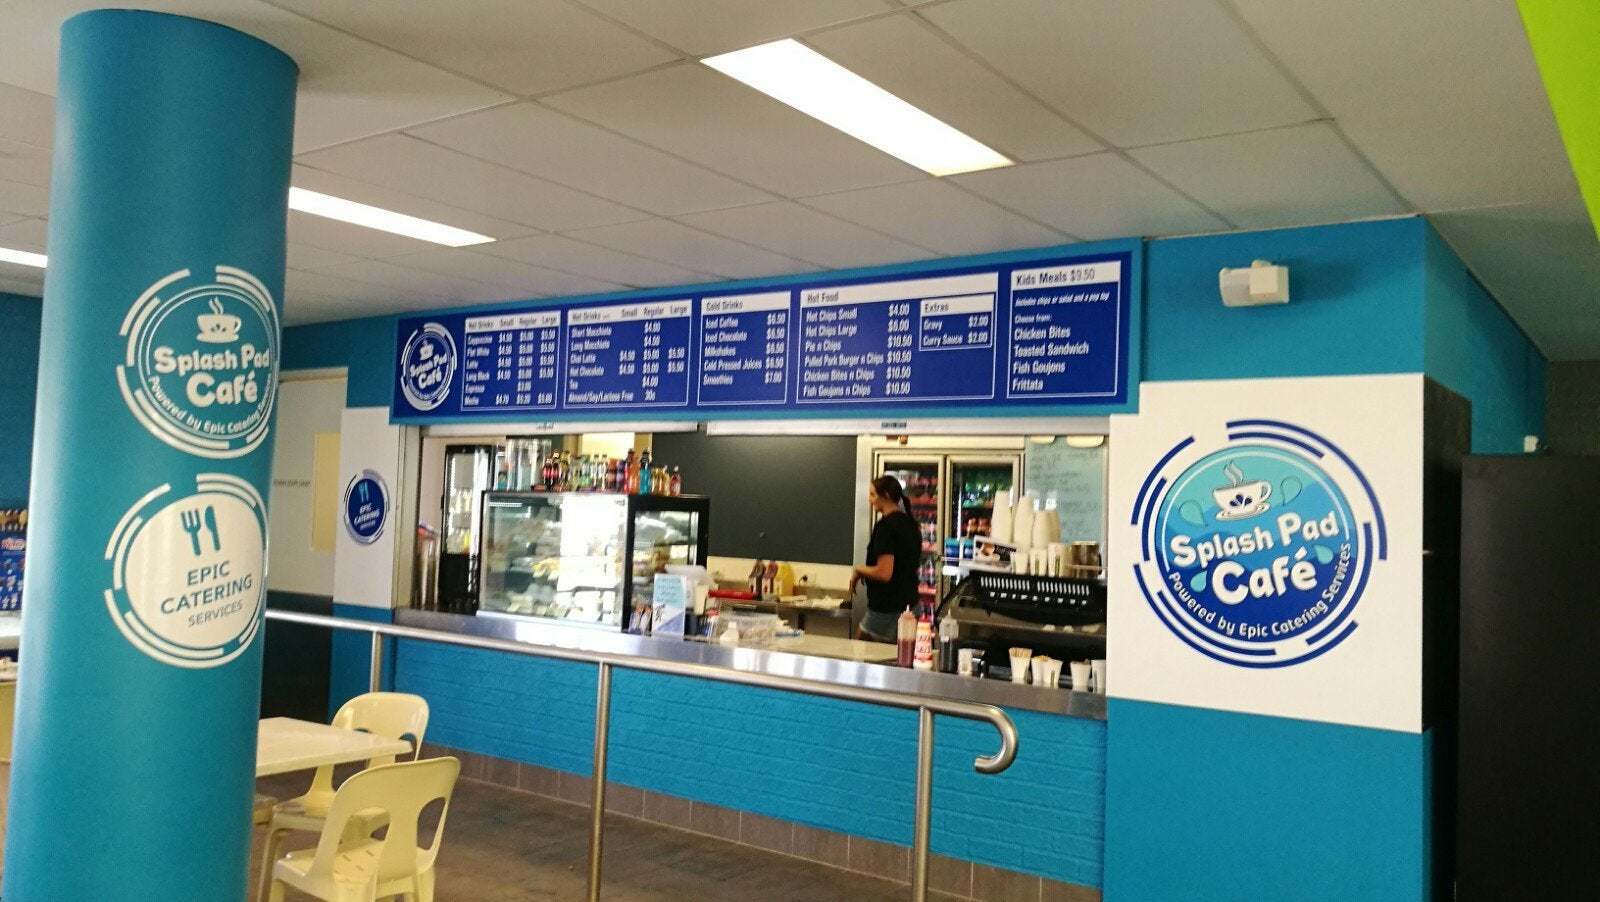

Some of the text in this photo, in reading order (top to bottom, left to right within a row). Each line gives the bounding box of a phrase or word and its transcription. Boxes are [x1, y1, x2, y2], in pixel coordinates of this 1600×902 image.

[1016, 268, 1095, 286] Kids Meals $9.50
[722, 300, 743, 310] Drinks
[808, 292, 838, 303] Hot Food
[1073, 293, 1084, 302] and
[670, 305, 688, 317] Large
[806, 303, 910, 322] Hot Chips Small $4.00
[924, 304, 949, 313] Extras
[924, 315, 988, 332] Gravy $2.00
[1015, 314, 1034, 324] Choose
[806, 326, 817, 337] Hot
[819, 324, 836, 338] Chips
[838, 324, 858, 336] Large
[1014, 326, 1071, 340] Chicken Bites
[805, 340, 816, 352] Pie
[816, 344, 822, 352] n
[823, 340, 842, 352] Chips
[923, 331, 988, 348] Curry Sauce $2.00
[1014, 341, 1089, 357] Toasted Sandwich
[154, 343, 270, 377] Splash Pad
[718, 359, 742, 370] Pressed
[742, 358, 762, 370] Juices
[838, 354, 860, 368] Burger
[866, 352, 884, 366] Chips
[1013, 360, 1066, 376] Fish Goujons
[804, 370, 830, 382] Chicken
[830, 369, 848, 382] Bites
[856, 368, 874, 382] Chips
[186, 370, 258, 408] Café
[803, 384, 817, 397] Fish
[852, 383, 871, 398] Chips
[1012, 378, 1044, 391] Frittata
[148, 375, 187, 420] Powered
[186, 413, 202, 431] by
[203, 420, 226, 435] Epic
[1170, 510, 1340, 570] Splash Pad
[186, 560, 230, 586] EPIC
[1211, 546, 1318, 606] Café
[160, 572, 252, 615] CATERING
[1168, 542, 1352, 640] Powered by Epic Catering Services
[188, 598, 244, 628] SERVICES
